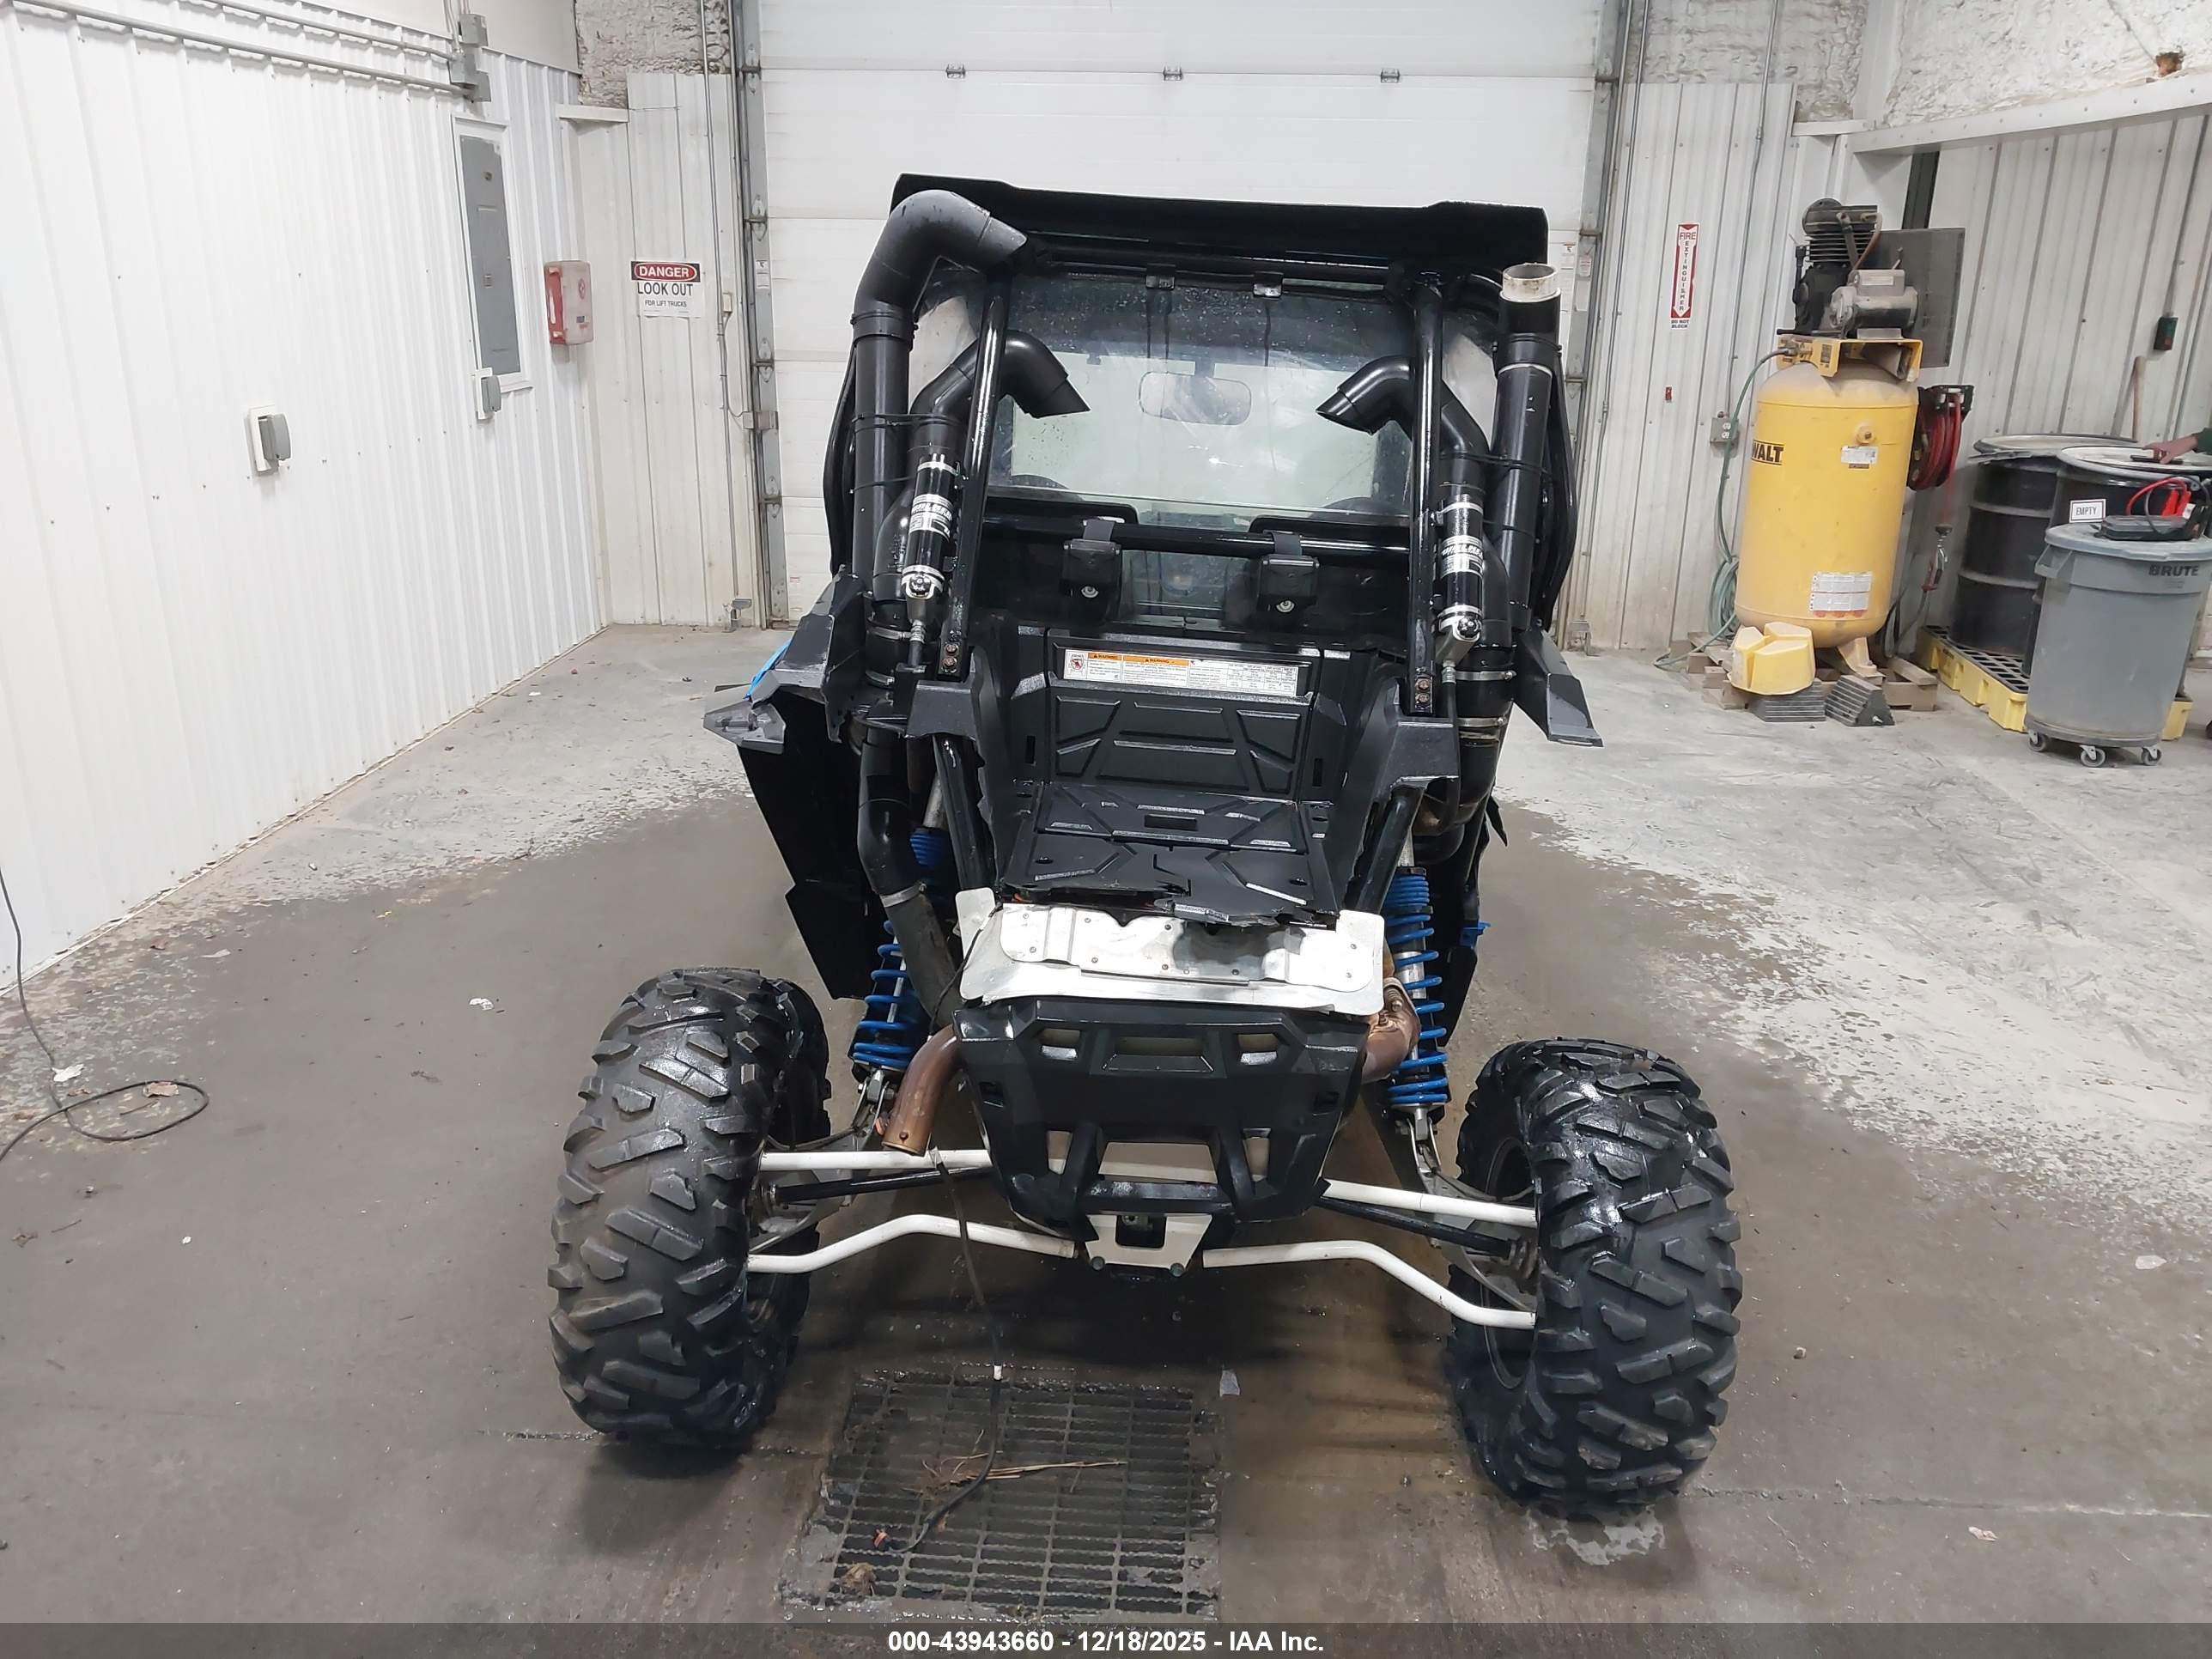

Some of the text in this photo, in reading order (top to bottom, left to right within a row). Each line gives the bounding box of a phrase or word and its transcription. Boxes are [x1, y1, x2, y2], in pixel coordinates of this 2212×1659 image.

[1680, 232, 1696, 240] FIRE
[639, 265, 690, 278] DANGER
[1679, 240, 1690, 312] EXTINGUISHER
[637, 282, 693, 296] LOOK OUT
[2075, 506, 2098, 516] EMPTY
[2148, 563, 2199, 577] BRUTE
